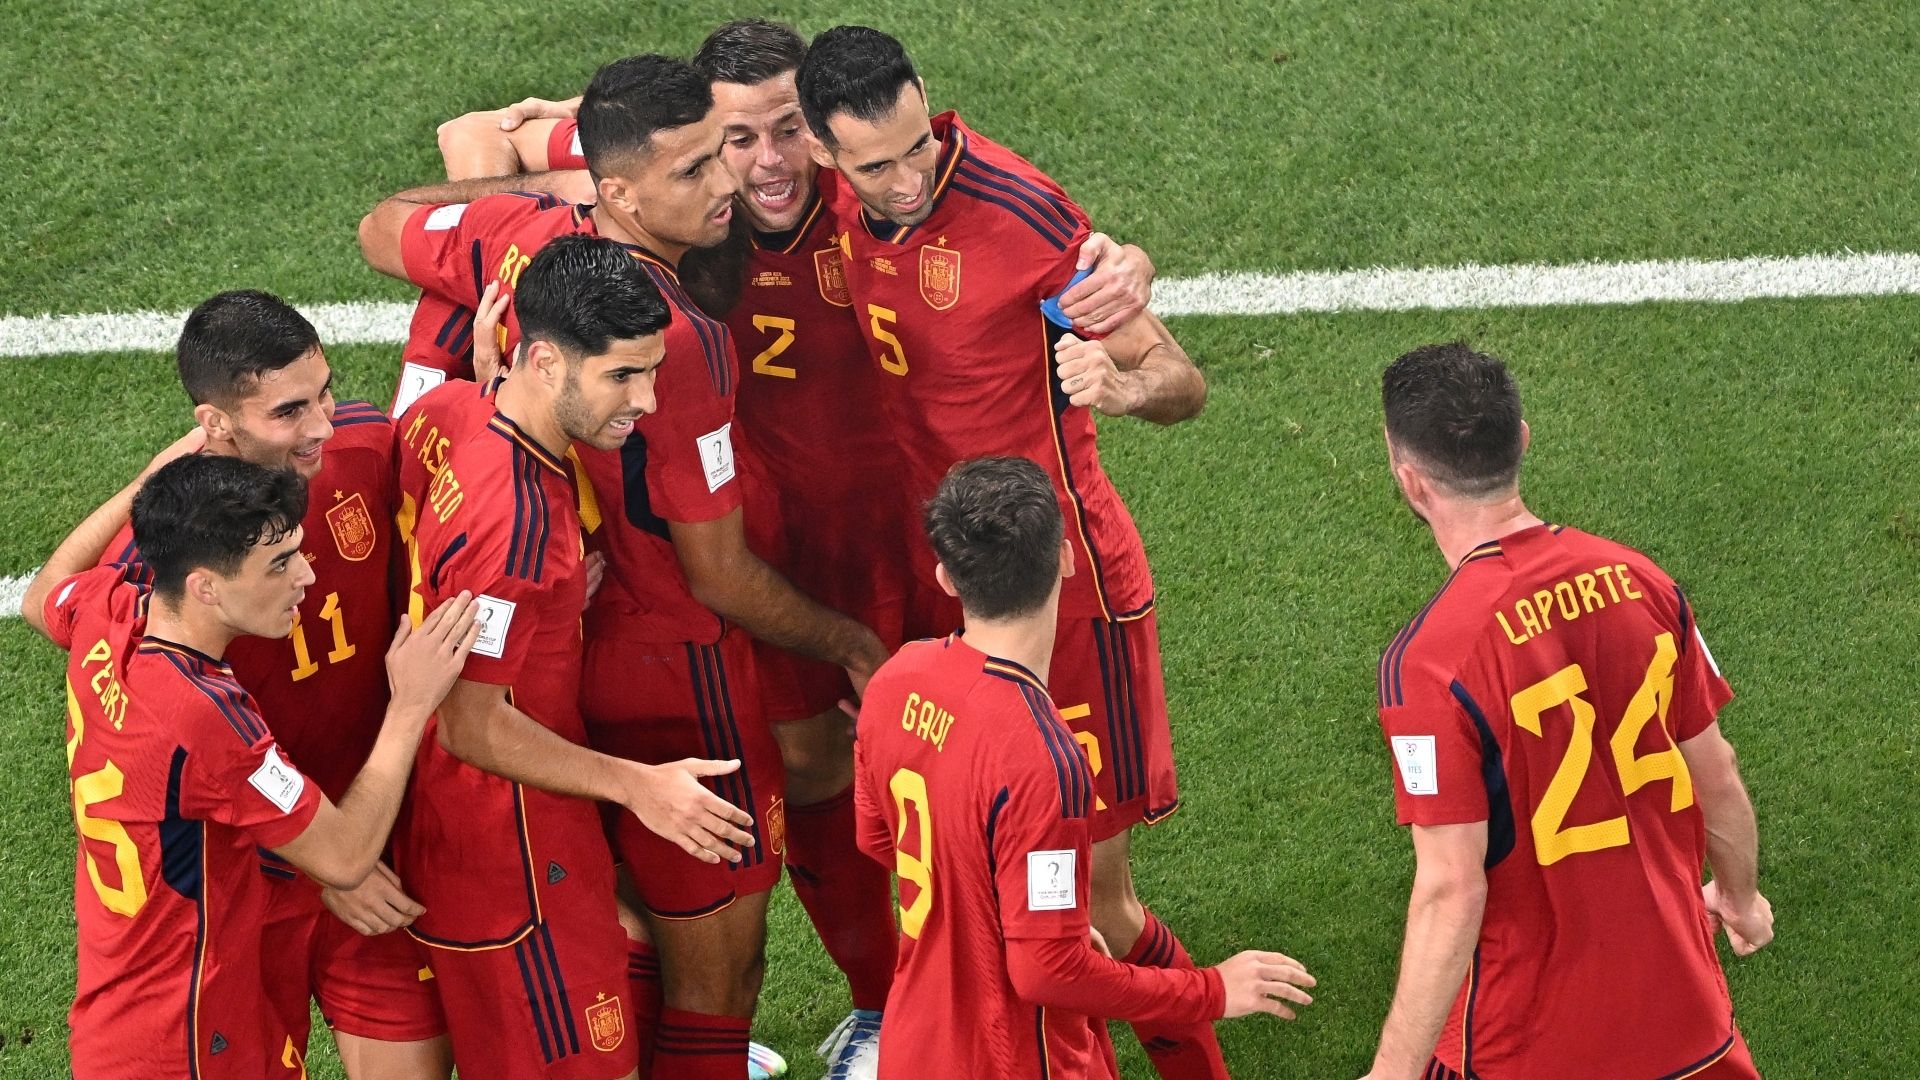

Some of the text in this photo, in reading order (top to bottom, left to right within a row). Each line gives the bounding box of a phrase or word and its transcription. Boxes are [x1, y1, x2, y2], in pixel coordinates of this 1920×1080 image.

[752, 314, 796, 379] 2
[868, 303, 909, 376] 5
[288, 592, 355, 682] 11
[1495, 563, 1642, 645] LAPORTE
[901, 692, 954, 752] GAVI
[1510, 631, 1694, 866] 24
[889, 768, 932, 940] 9
